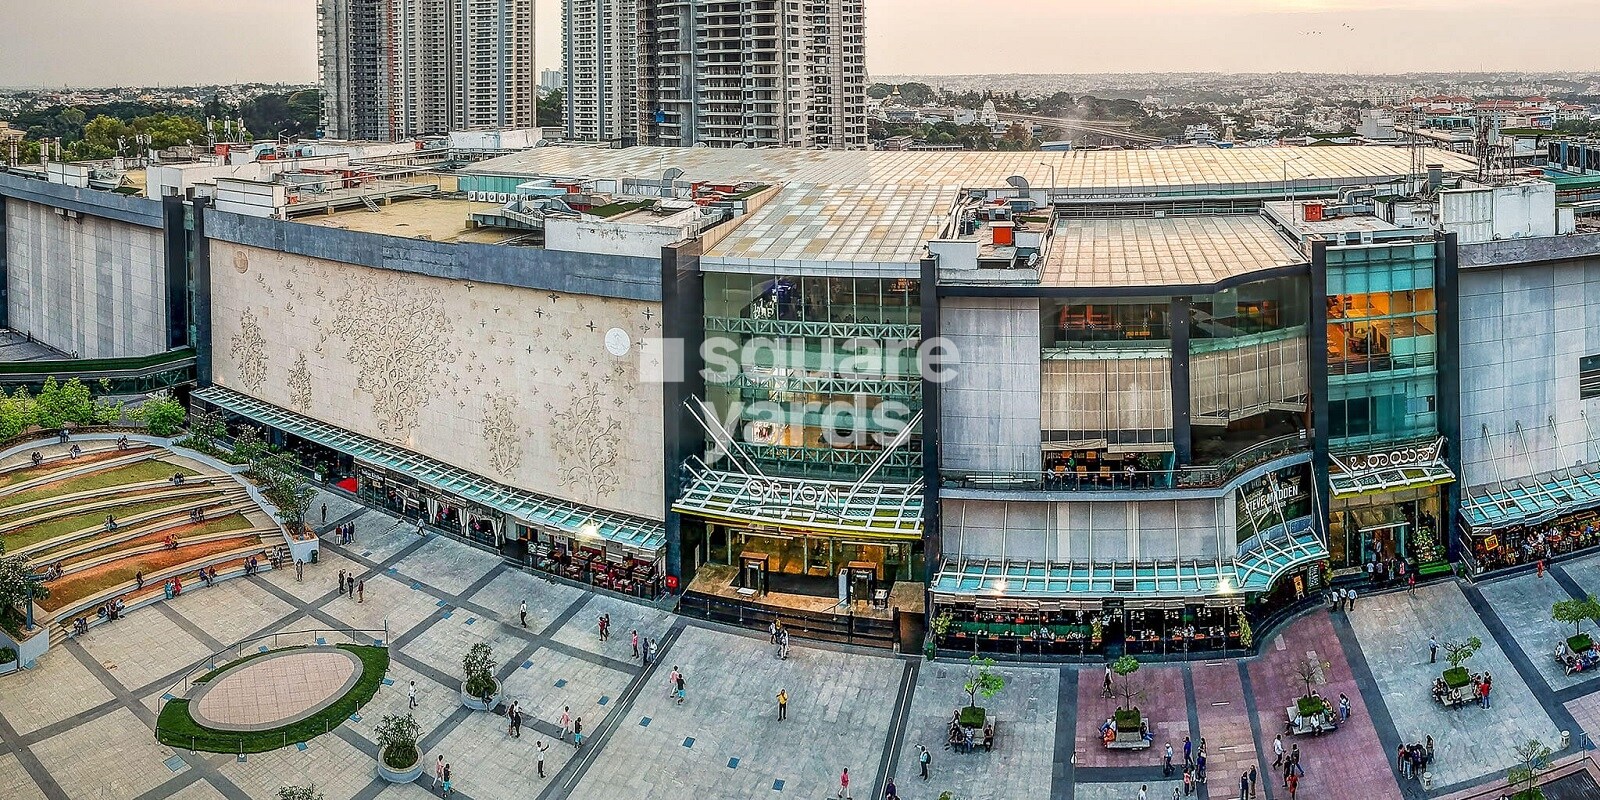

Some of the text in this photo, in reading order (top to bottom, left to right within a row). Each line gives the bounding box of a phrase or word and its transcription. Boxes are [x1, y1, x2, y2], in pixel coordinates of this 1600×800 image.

[1350, 443, 1436, 471] ಒರಾಯನ್
[747, 480, 840, 505] ORION
[1246, 485, 1298, 514] STEVE MADDEN
